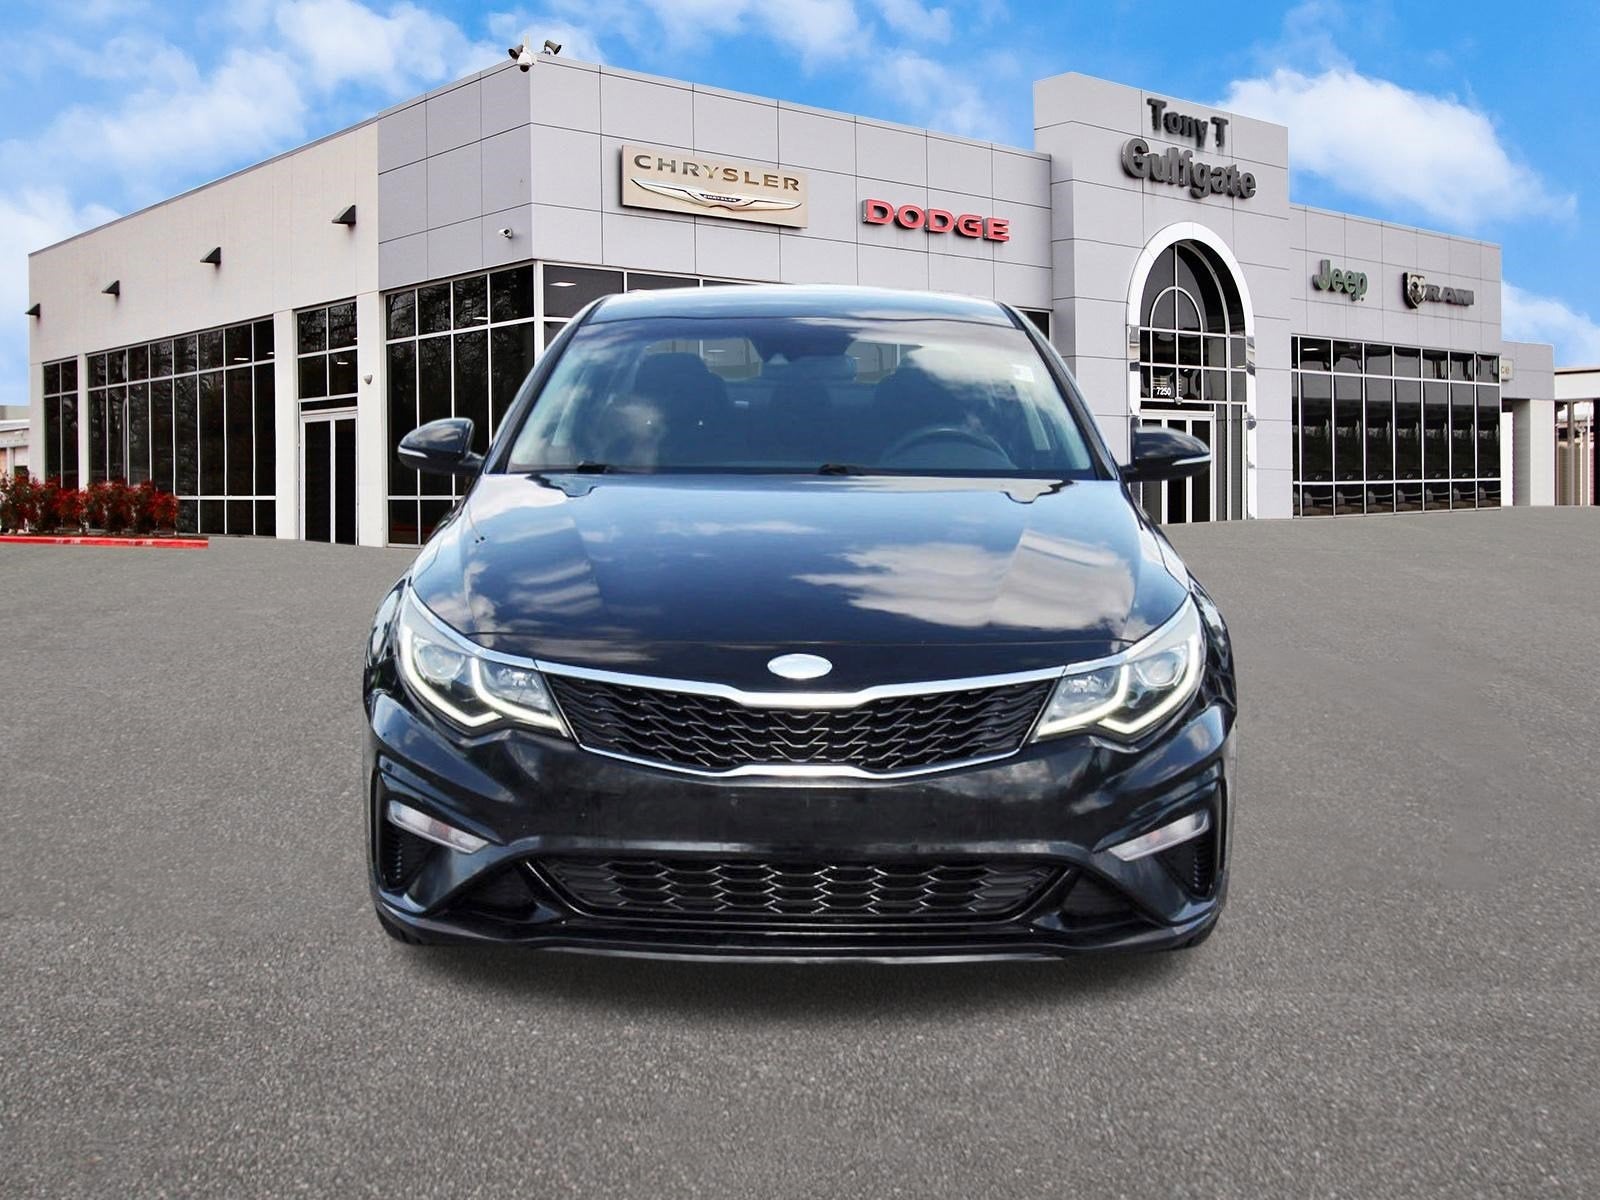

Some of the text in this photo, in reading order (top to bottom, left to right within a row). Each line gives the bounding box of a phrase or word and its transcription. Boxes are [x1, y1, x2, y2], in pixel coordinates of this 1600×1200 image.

[1147, 98, 1228, 148] Tony T
[633, 154, 800, 192] CHRYSLER
[1121, 137, 1256, 199] Gulfgate
[862, 198, 1010, 242] DODGE
[1312, 259, 1368, 301] Jeep
[1425, 283, 1475, 306] RAM
